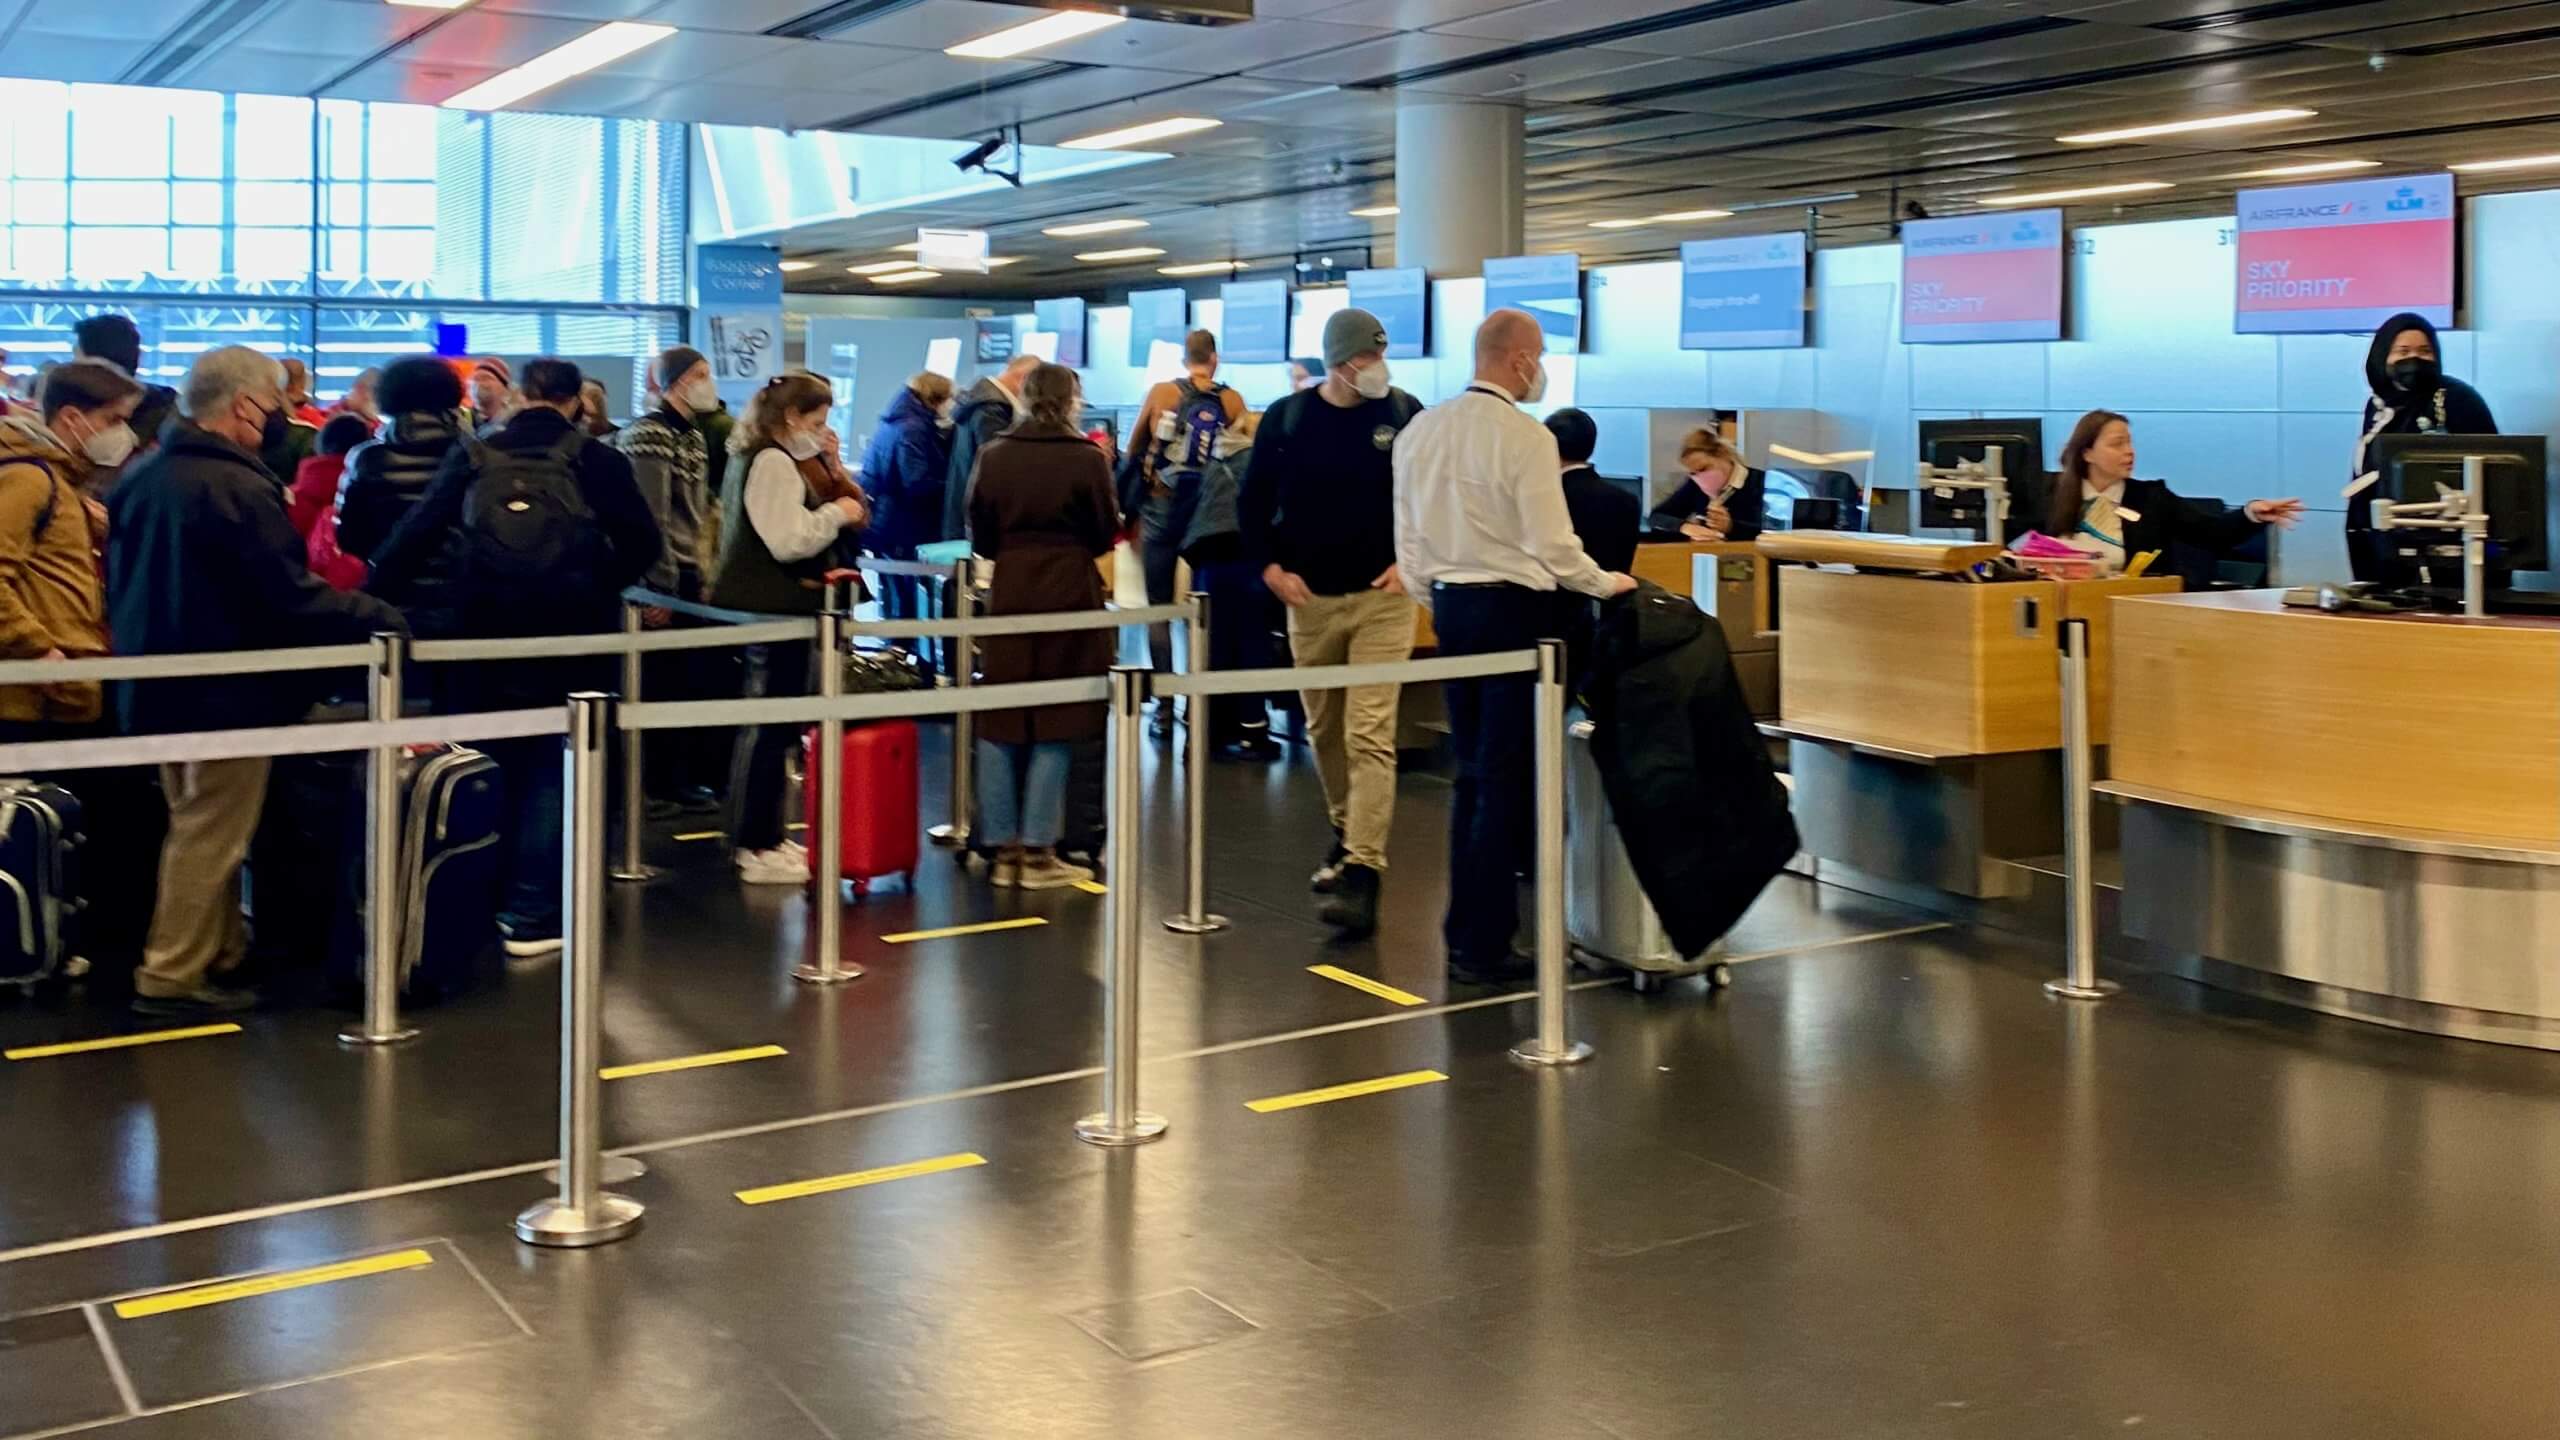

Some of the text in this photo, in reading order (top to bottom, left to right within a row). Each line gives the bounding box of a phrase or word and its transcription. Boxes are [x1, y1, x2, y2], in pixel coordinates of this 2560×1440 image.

[2250, 204, 2338, 221] AIRFRANCE
[2386, 197, 2424, 212] KLM
[2247, 261, 2290, 279] SKY
[1909, 282, 1944, 299] SKY
[2247, 278, 2355, 299] PRIORITY
